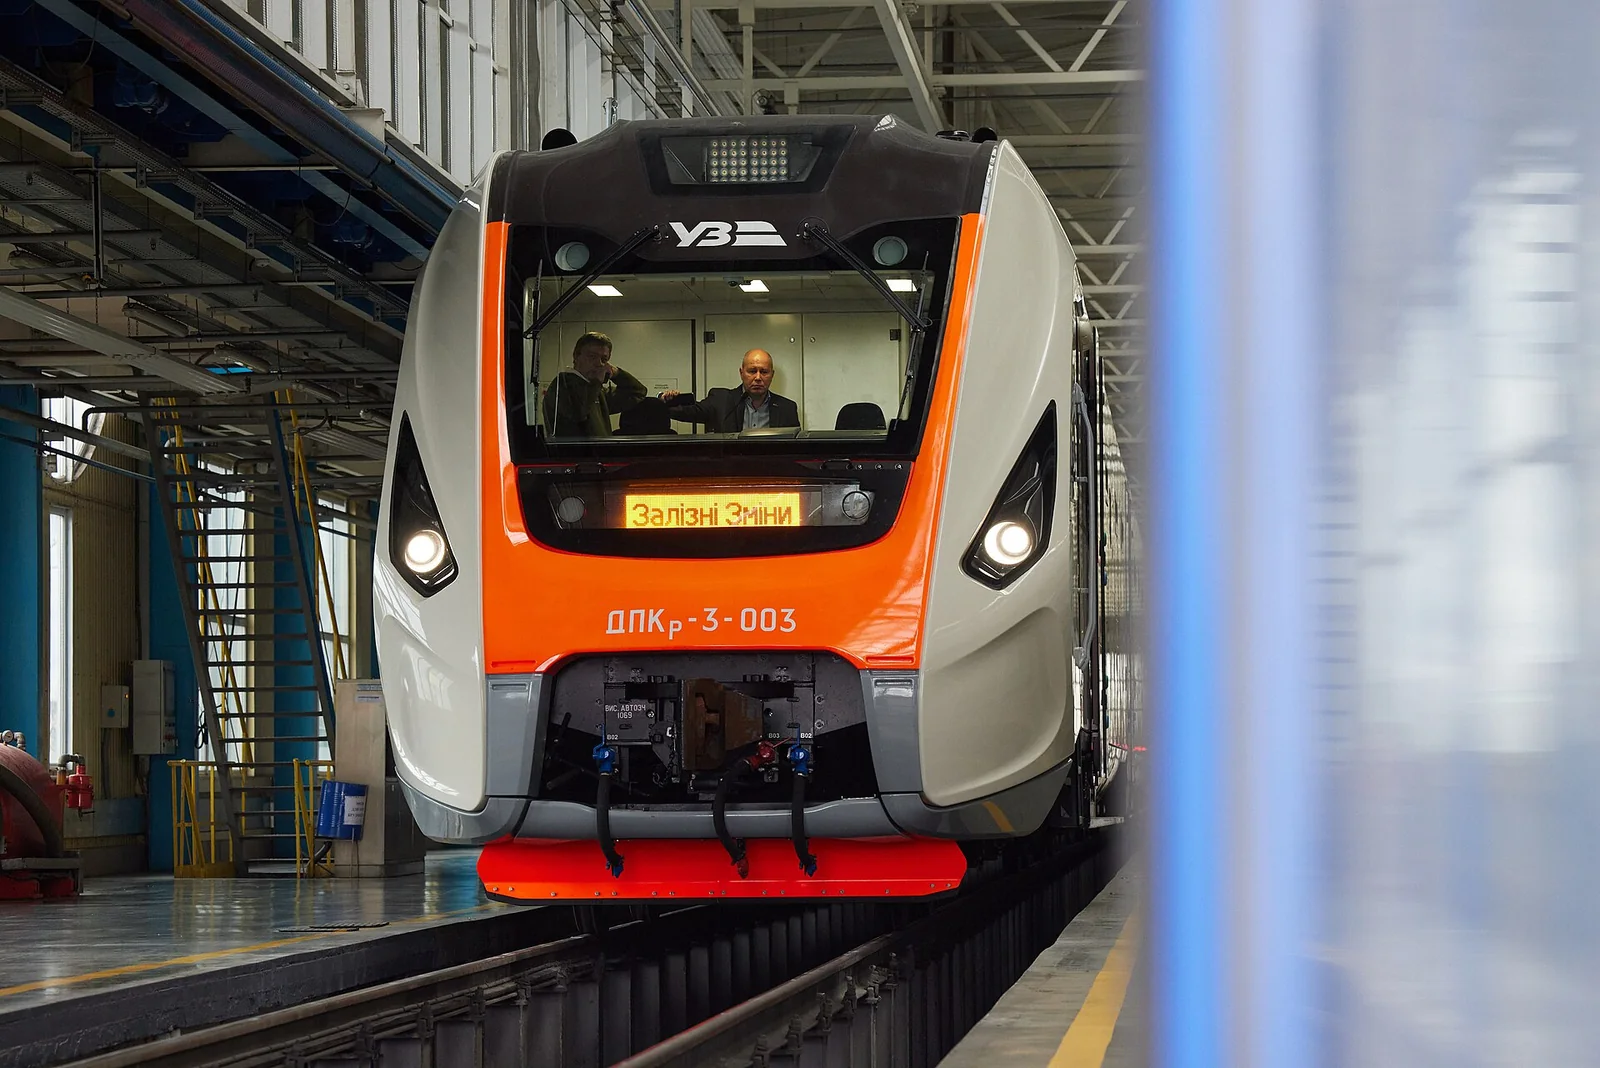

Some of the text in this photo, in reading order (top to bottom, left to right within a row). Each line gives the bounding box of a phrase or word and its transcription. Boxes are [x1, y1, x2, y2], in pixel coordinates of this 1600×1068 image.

[632, 502, 792, 526] Залізні Зміни
[617, 711, 633, 719] 1069
